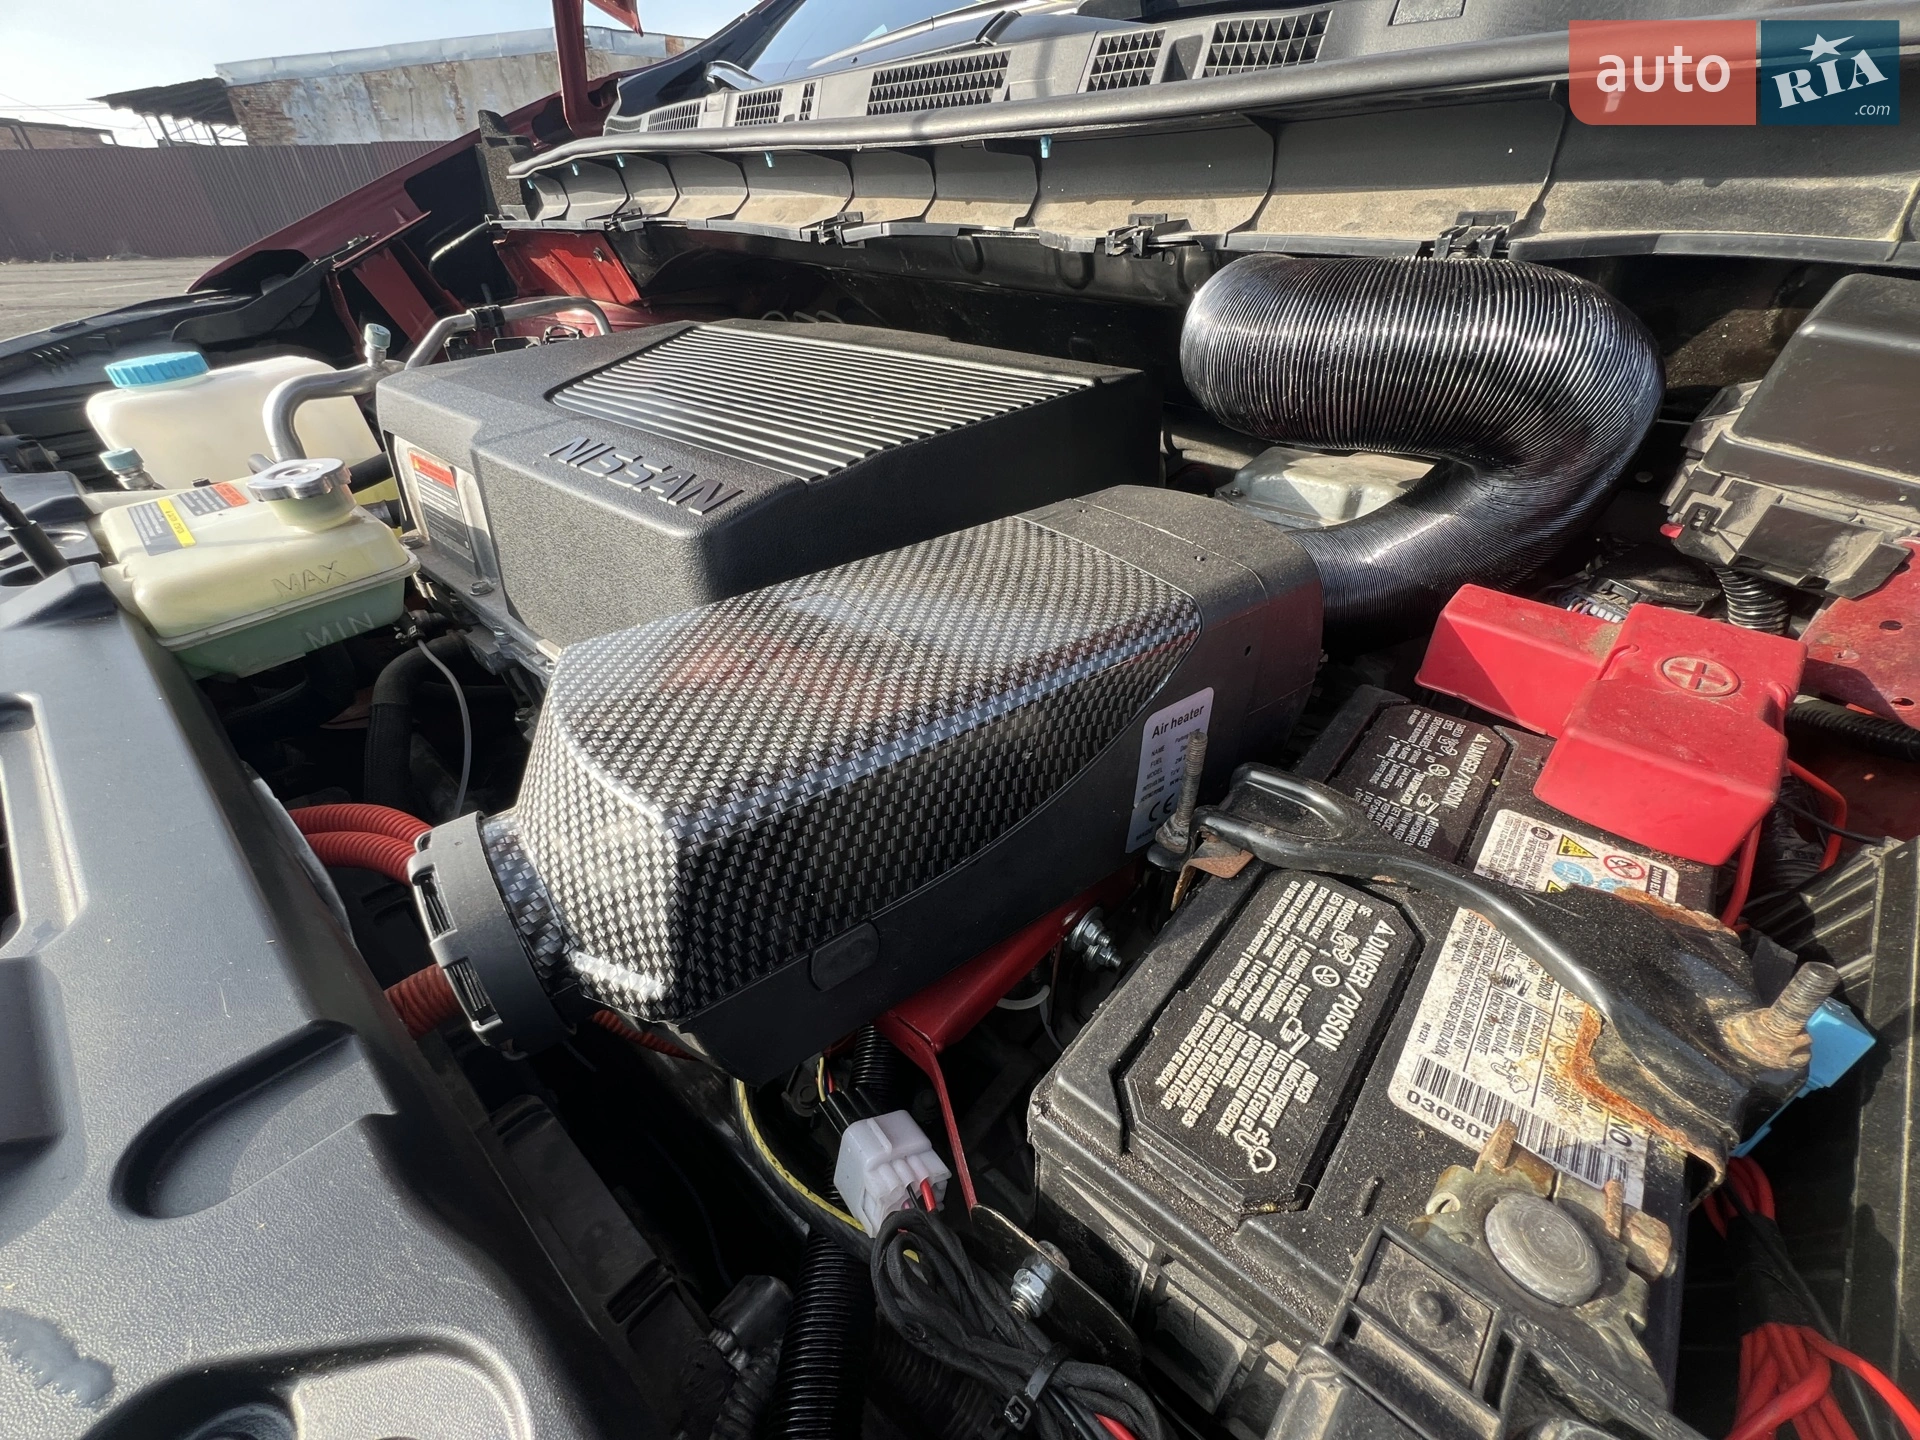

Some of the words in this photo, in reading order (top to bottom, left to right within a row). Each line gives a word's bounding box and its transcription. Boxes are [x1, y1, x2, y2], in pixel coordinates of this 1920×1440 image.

[543, 434, 745, 516] NISSAN
[271, 560, 347, 597] MAX
[305, 612, 375, 649] MIN
[1152, 721, 1169, 739] Air
[1170, 704, 1205, 729] heater
[1356, 905, 1372, 918] SE
[1240, 1036, 1261, 1060] SANS
[1270, 1052, 1290, 1072] LES
[1241, 1044, 1275, 1091] CONSULTER
[1260, 1067, 1281, 1092] YEUX
[1293, 1070, 1319, 1105] RINCER
[1608, 1115, 1634, 1147] NO
